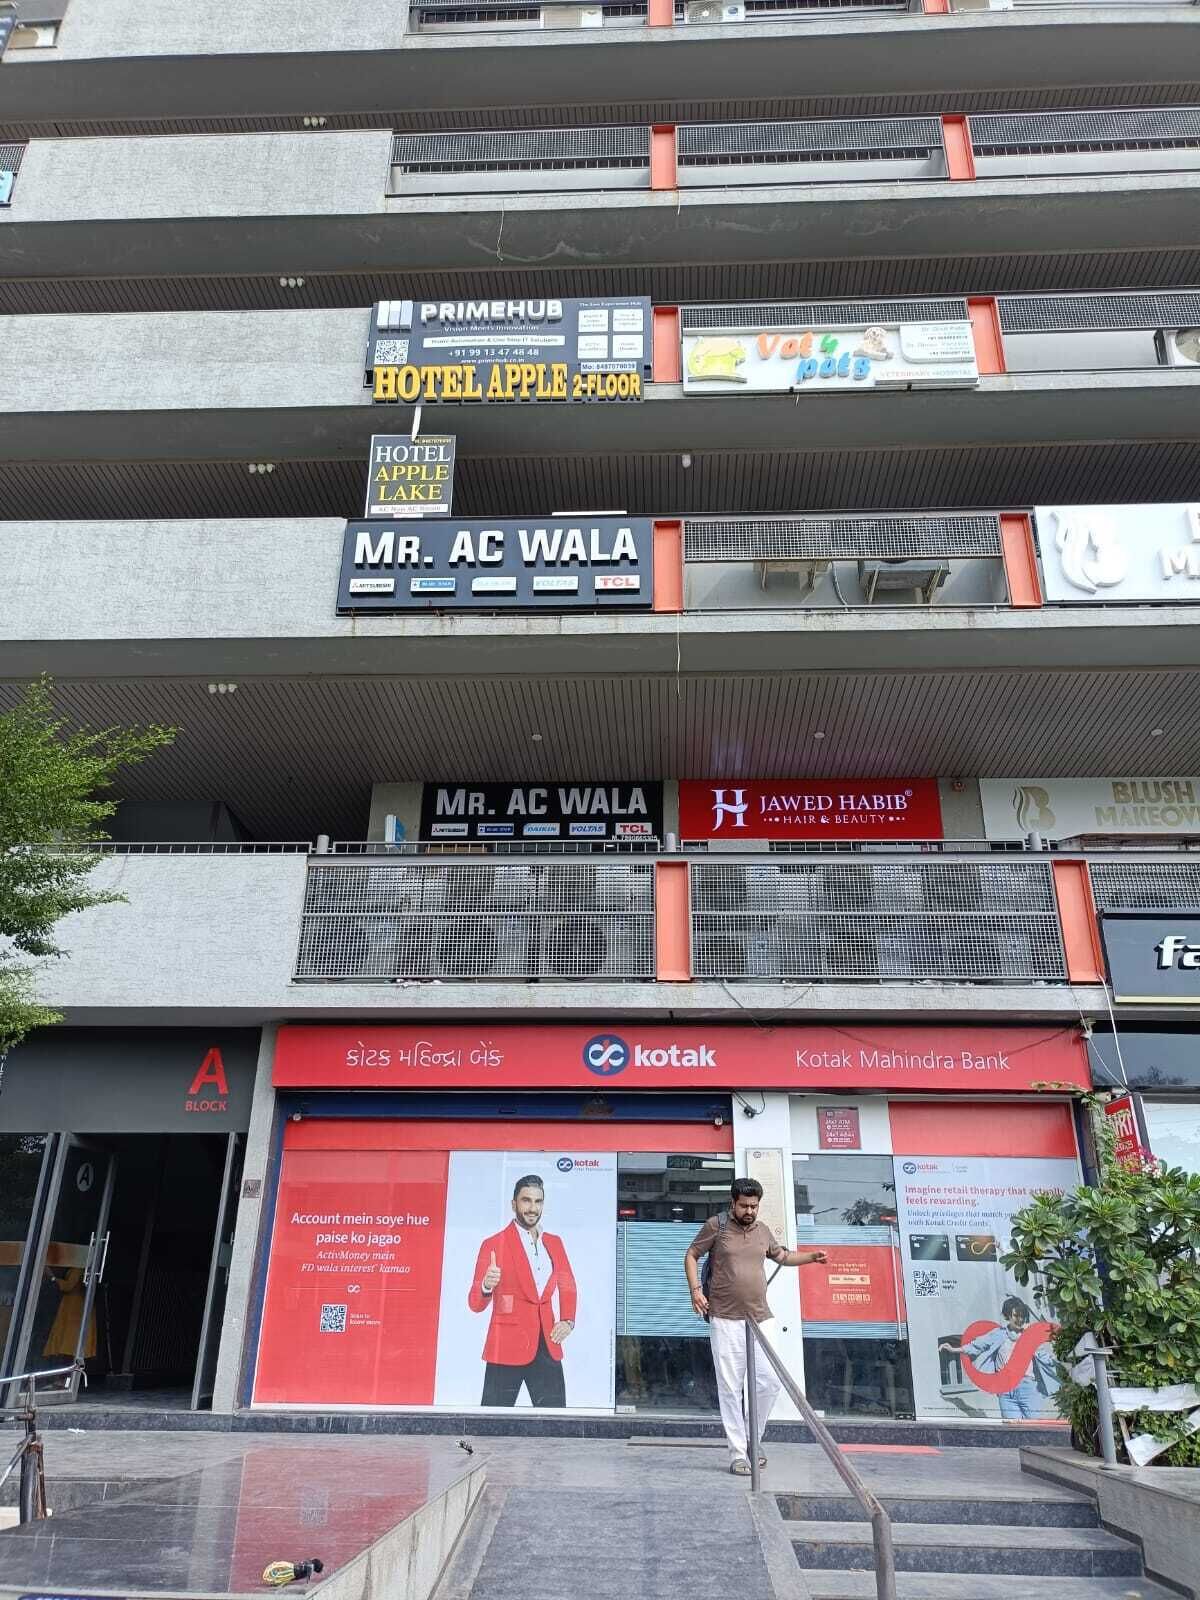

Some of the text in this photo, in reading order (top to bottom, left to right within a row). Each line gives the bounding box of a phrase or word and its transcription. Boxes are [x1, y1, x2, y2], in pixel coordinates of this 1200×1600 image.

[420, 300, 563, 322] PRIMEHUB
[469, 349, 481, 357] 99
[373, 363, 640, 400] HOTEL APPLE 2-FLOOR
[374, 445, 451, 462] HOTEL
[374, 465, 450, 481] APPLE
[378, 484, 442, 500] LAKE
[449, 530, 505, 564] AC
[519, 527, 638, 564] WALA
[600, 577, 635, 587] TCL
[1111, 781, 1196, 804] BLUSH
[506, 788, 548, 815] AC
[558, 787, 648, 815] WALA
[760, 795, 907, 814] JAWED HABIB
[783, 814, 884, 824] HAIR & BEAUTY
[1095, 805, 1200, 827] MAKEOV
[571, 825, 604, 833] VOLTAS
[619, 824, 649, 834] TCL
[346, 1041, 391, 1066] કોટક
[399, 1041, 462, 1067] મહિન્દ્રા
[635, 1044, 716, 1067] kotak
[796, 1051, 1010, 1071] Kotak Mahindra Bank
[188, 1048, 228, 1094] A
[185, 1101, 226, 1111] BLOCK
[905, 1186, 941, 1195] Imagine
[970, 1187, 1005, 1197] therapy
[1029, 1188, 1065, 1197] actually
[906, 1196, 979, 1207] feels rewarding.
[291, 1212, 429, 1227] Account mein soye hue
[932, 1210, 965, 1219] privileges
[316, 1231, 402, 1246] paise ko jagao
[316, 1250, 395, 1261] ActivMoney mein
[301, 1263, 315, 1272] FD
[317, 1263, 338, 1272] wala
[379, 1263, 411, 1273] kamao
